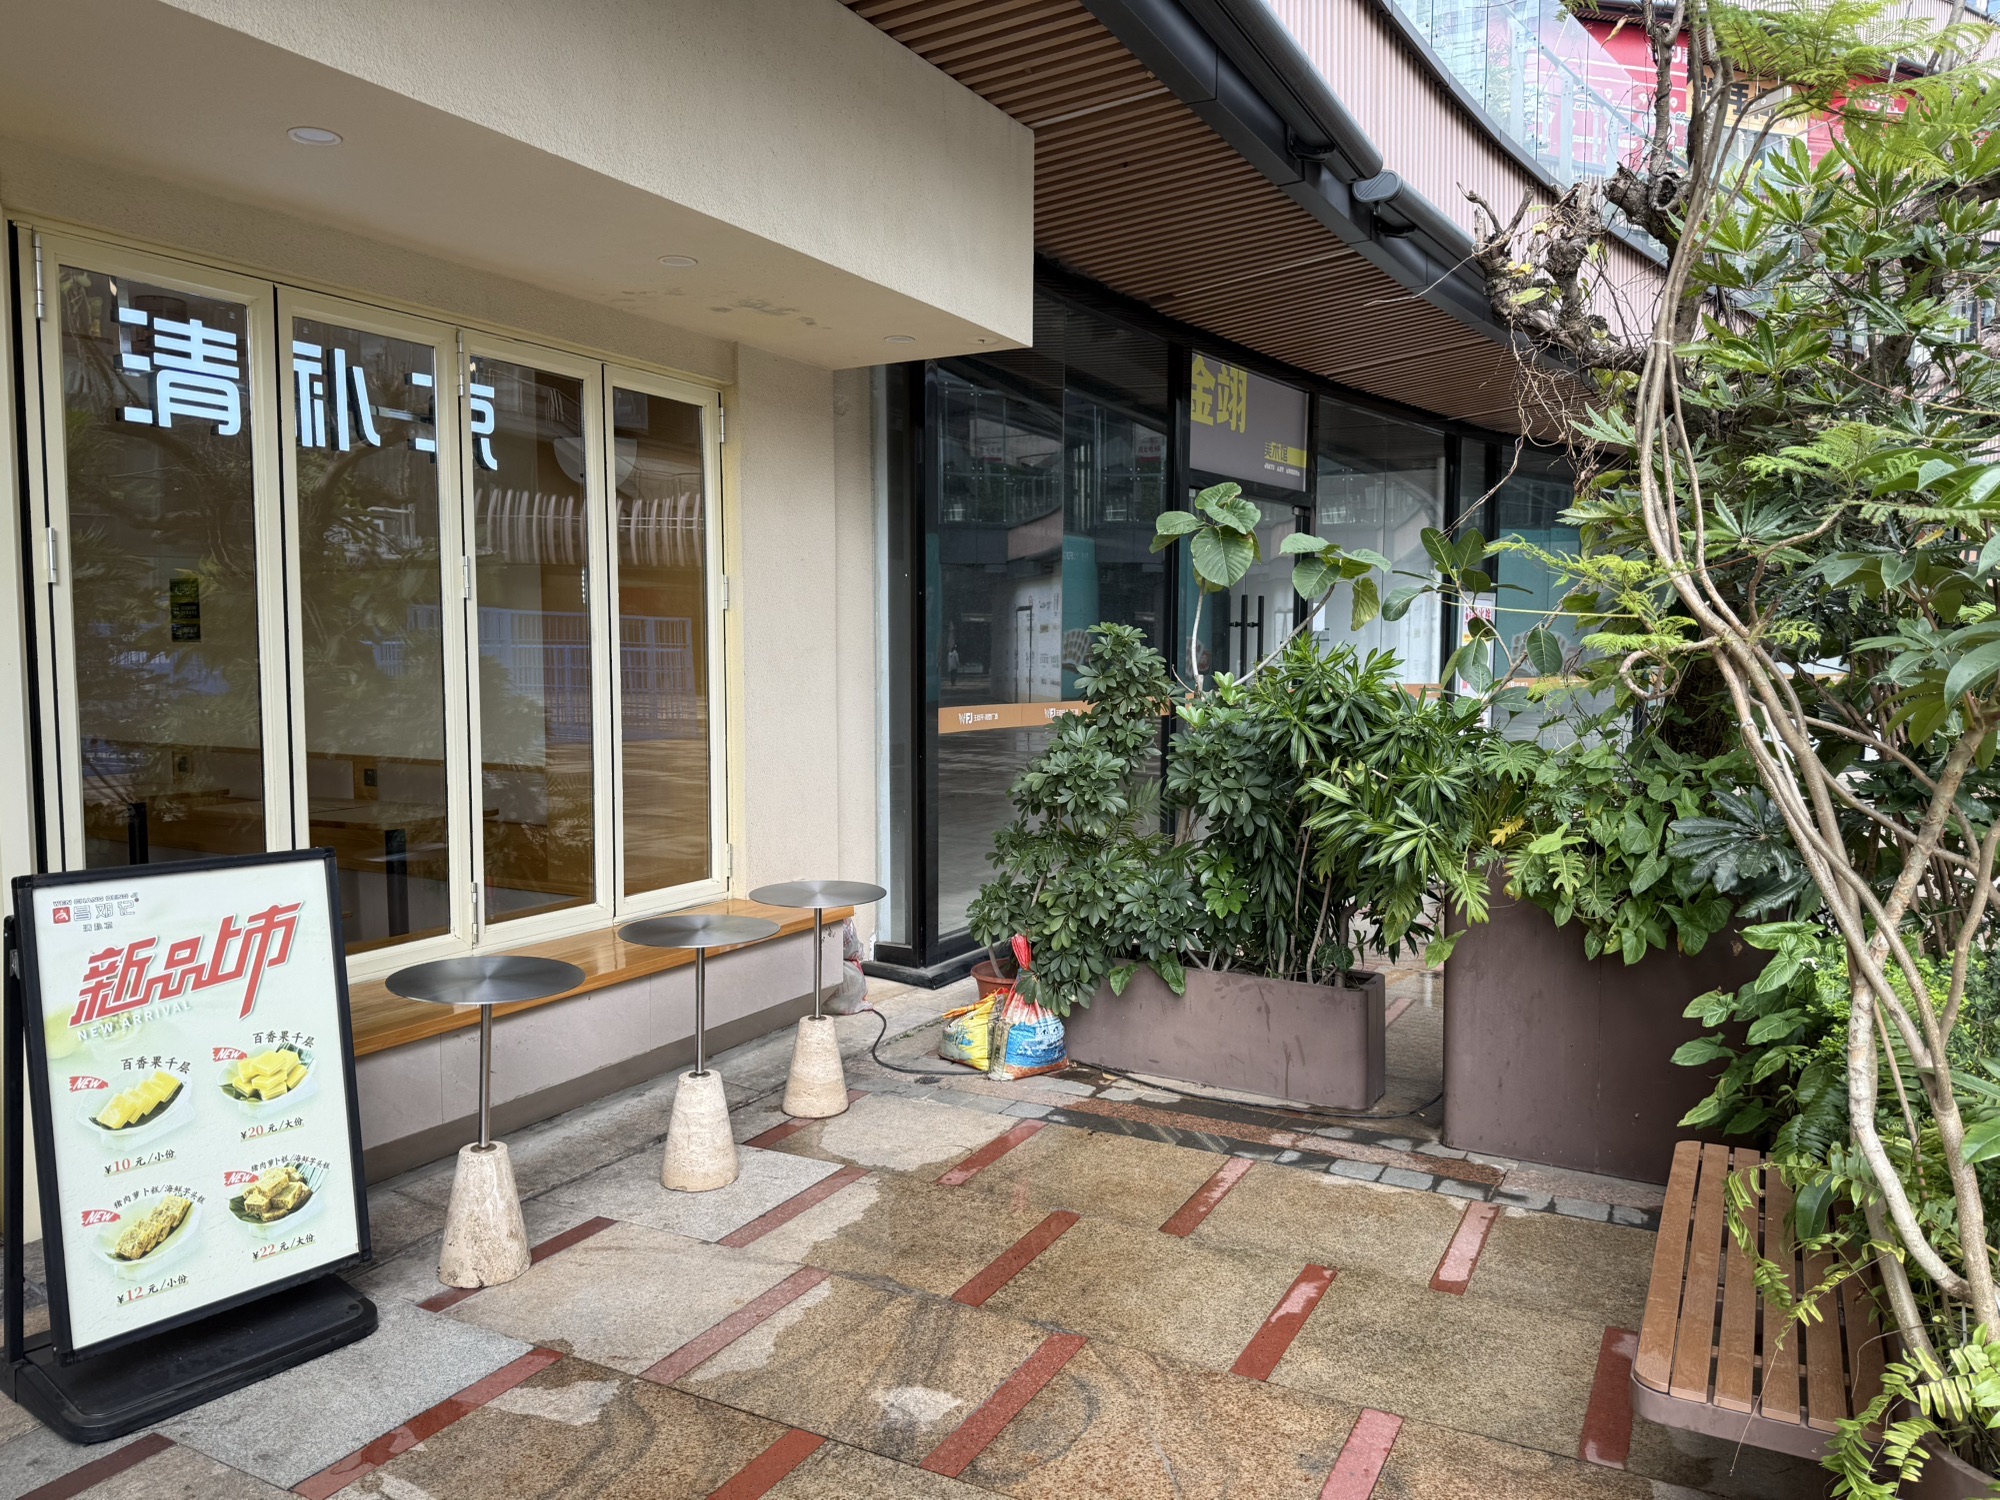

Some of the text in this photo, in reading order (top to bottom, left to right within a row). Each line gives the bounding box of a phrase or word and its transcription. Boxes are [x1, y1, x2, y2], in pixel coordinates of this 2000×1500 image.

[69, 901, 304, 1028] 新品上市
[77, 1000, 191, 1042] NEW ARRIVAL
[252, 1030, 315, 1048] 百香果千层
[216, 1048, 241, 1060] NEW
[121, 1056, 191, 1074] 百香果千层
[73, 1077, 102, 1090] NEW
[227, 1173, 253, 1186] NEW
[85, 1211, 114, 1225] NEW
